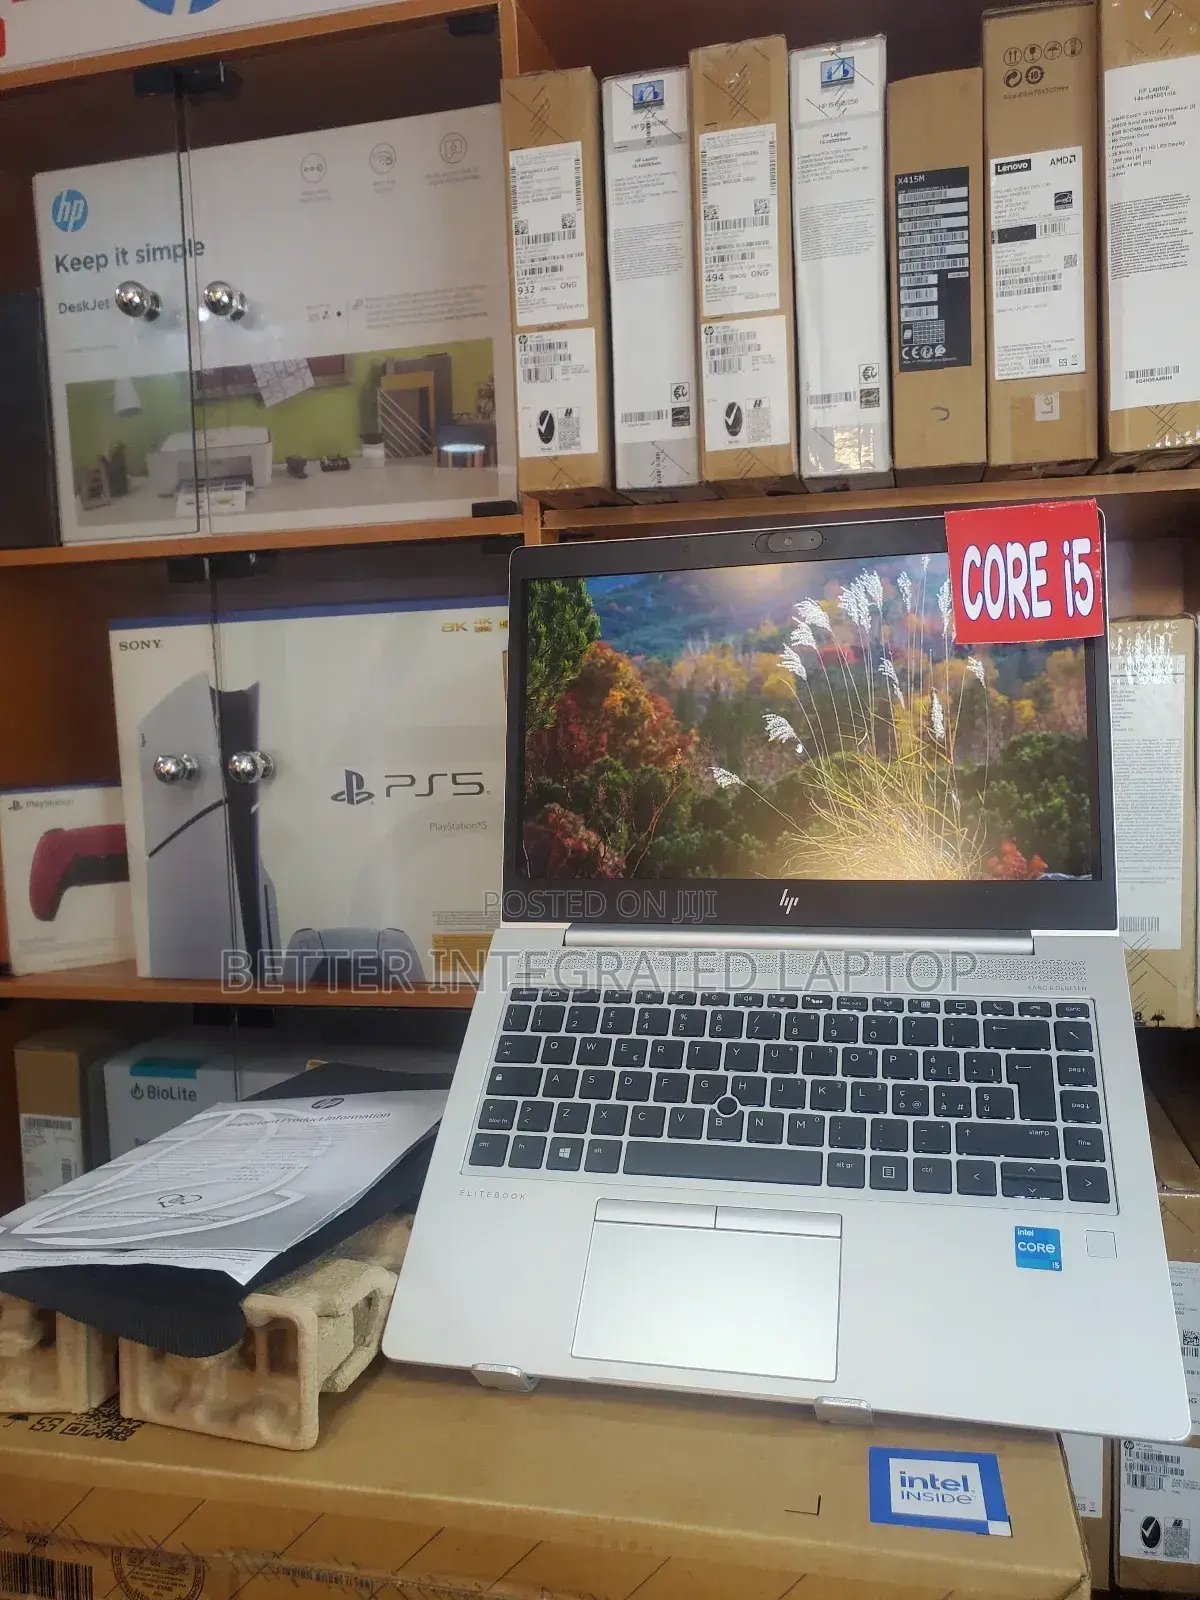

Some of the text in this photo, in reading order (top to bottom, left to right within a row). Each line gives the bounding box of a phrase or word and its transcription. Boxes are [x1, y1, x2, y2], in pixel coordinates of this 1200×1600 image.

[1149, 85, 1170, 93] Laptop
[998, 162, 1028, 173] Lenovo
[1050, 156, 1069, 166] AMD
[897, 174, 925, 185] X415M
[52, 189, 89, 232] hp
[54, 238, 206, 274] Keep it simple
[705, 273, 725, 283] 494
[751, 270, 770, 278] ONG
[518, 286, 535, 295] 932
[560, 282, 578, 290] ONG
[58, 298, 110, 315] DeskJet
[962, 538, 1094, 621] CORE i5
[441, 621, 468, 633] 8K
[118, 639, 163, 652] SONY
[384, 772, 485, 798] PS5
[26, 798, 74, 810] PlayStation
[550, 1042, 559, 1050] Q
[147, 1086, 197, 1101] BioLite
[281, 1116, 323, 1125] Product
[324, 1112, 391, 1122] Information
[921, 1166, 933, 1174] ctrl
[460, 1190, 527, 1200] ELITEBOOK
[1018, 1228, 1034, 1237] intel
[900, 1471, 972, 1493] intel
[900, 1489, 974, 1505] INSIDE
